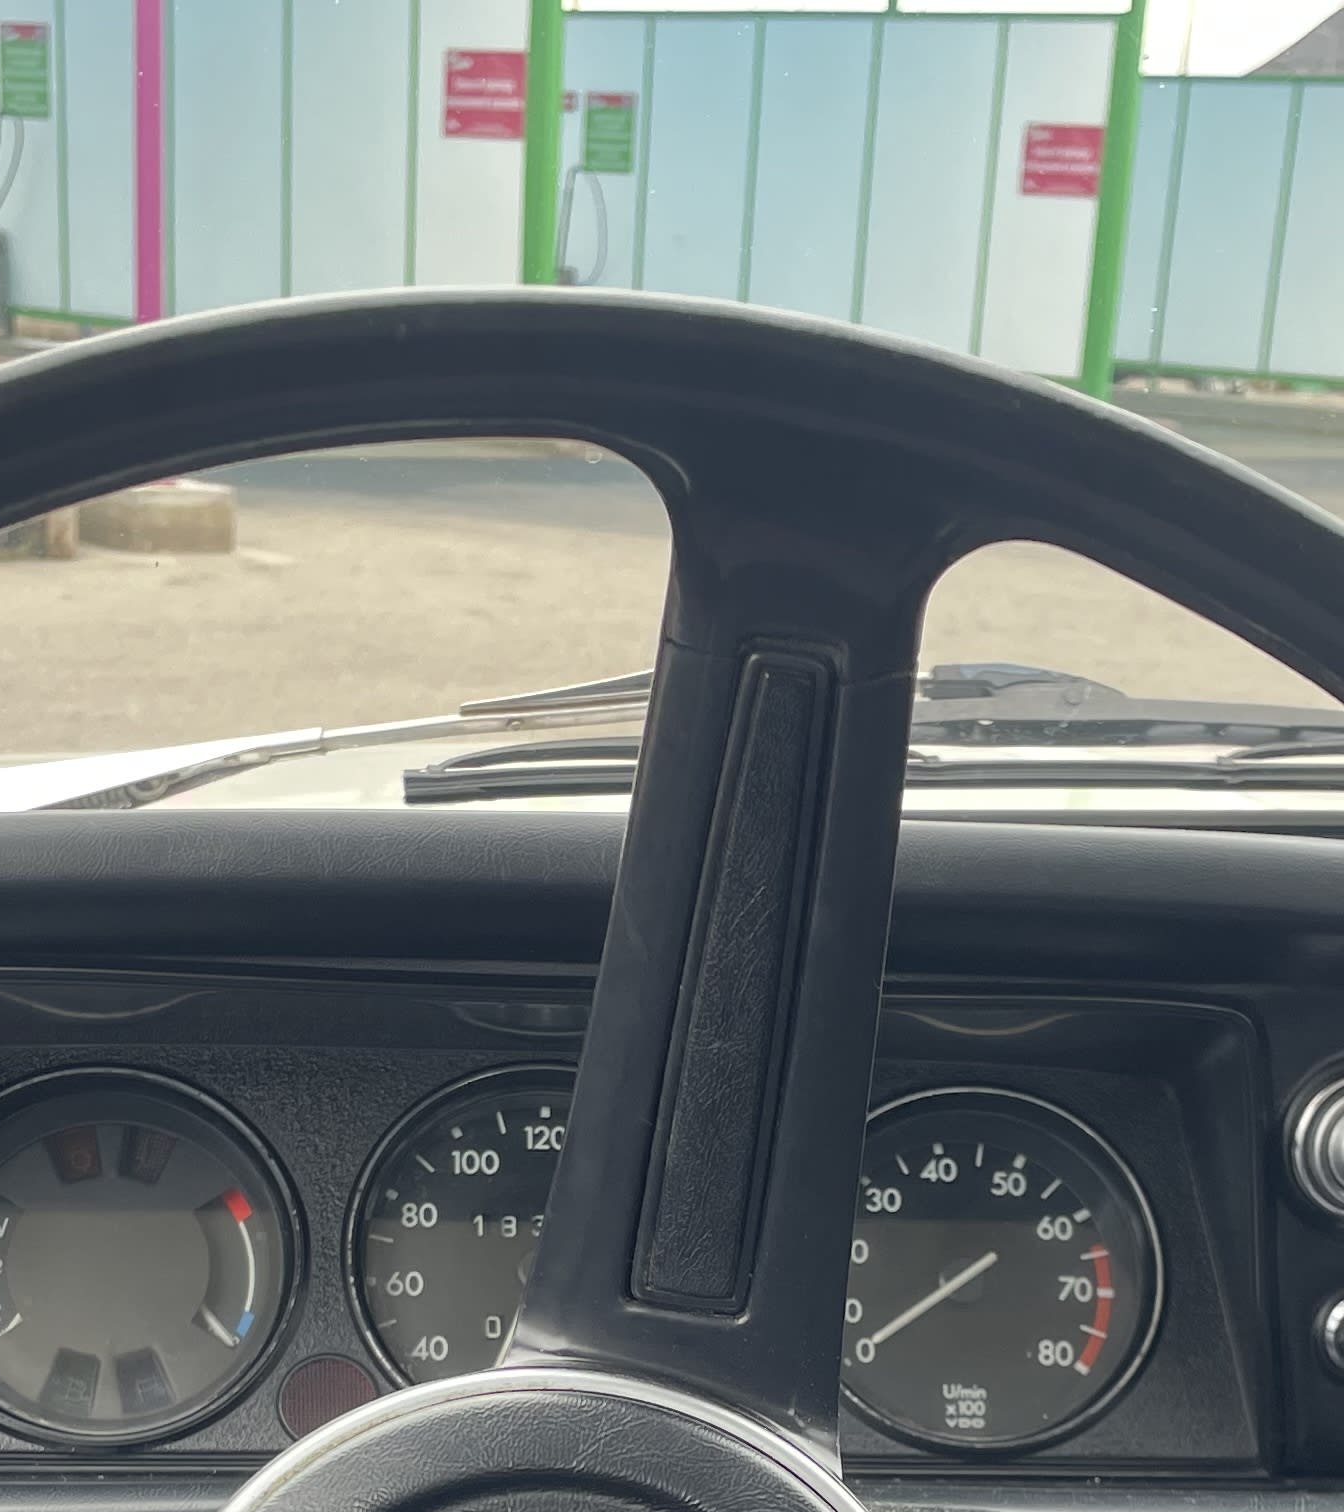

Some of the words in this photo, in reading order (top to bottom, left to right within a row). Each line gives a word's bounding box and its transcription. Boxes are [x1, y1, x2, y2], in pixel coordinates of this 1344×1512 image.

[524, 1125, 565, 1151] 120
[451, 1150, 500, 1175] 100
[920, 1157, 958, 1183] 40
[990, 1171, 1027, 1197] 50
[865, 1187, 902, 1213] 30
[401, 1202, 438, 1228] 80
[1036, 1215, 1073, 1241] 60
[851, 1239, 869, 1264] 0
[386, 1271, 424, 1297] 60
[1058, 1275, 1093, 1302] 70
[845, 1298, 863, 1323] 0
[485, 1316, 501, 1338] 0
[411, 1335, 449, 1362] 40
[856, 1338, 875, 1363] 0
[1038, 1340, 1074, 1367] 80
[942, 1384, 987, 1399] U/min
[945, 1401, 986, 1416] x100
